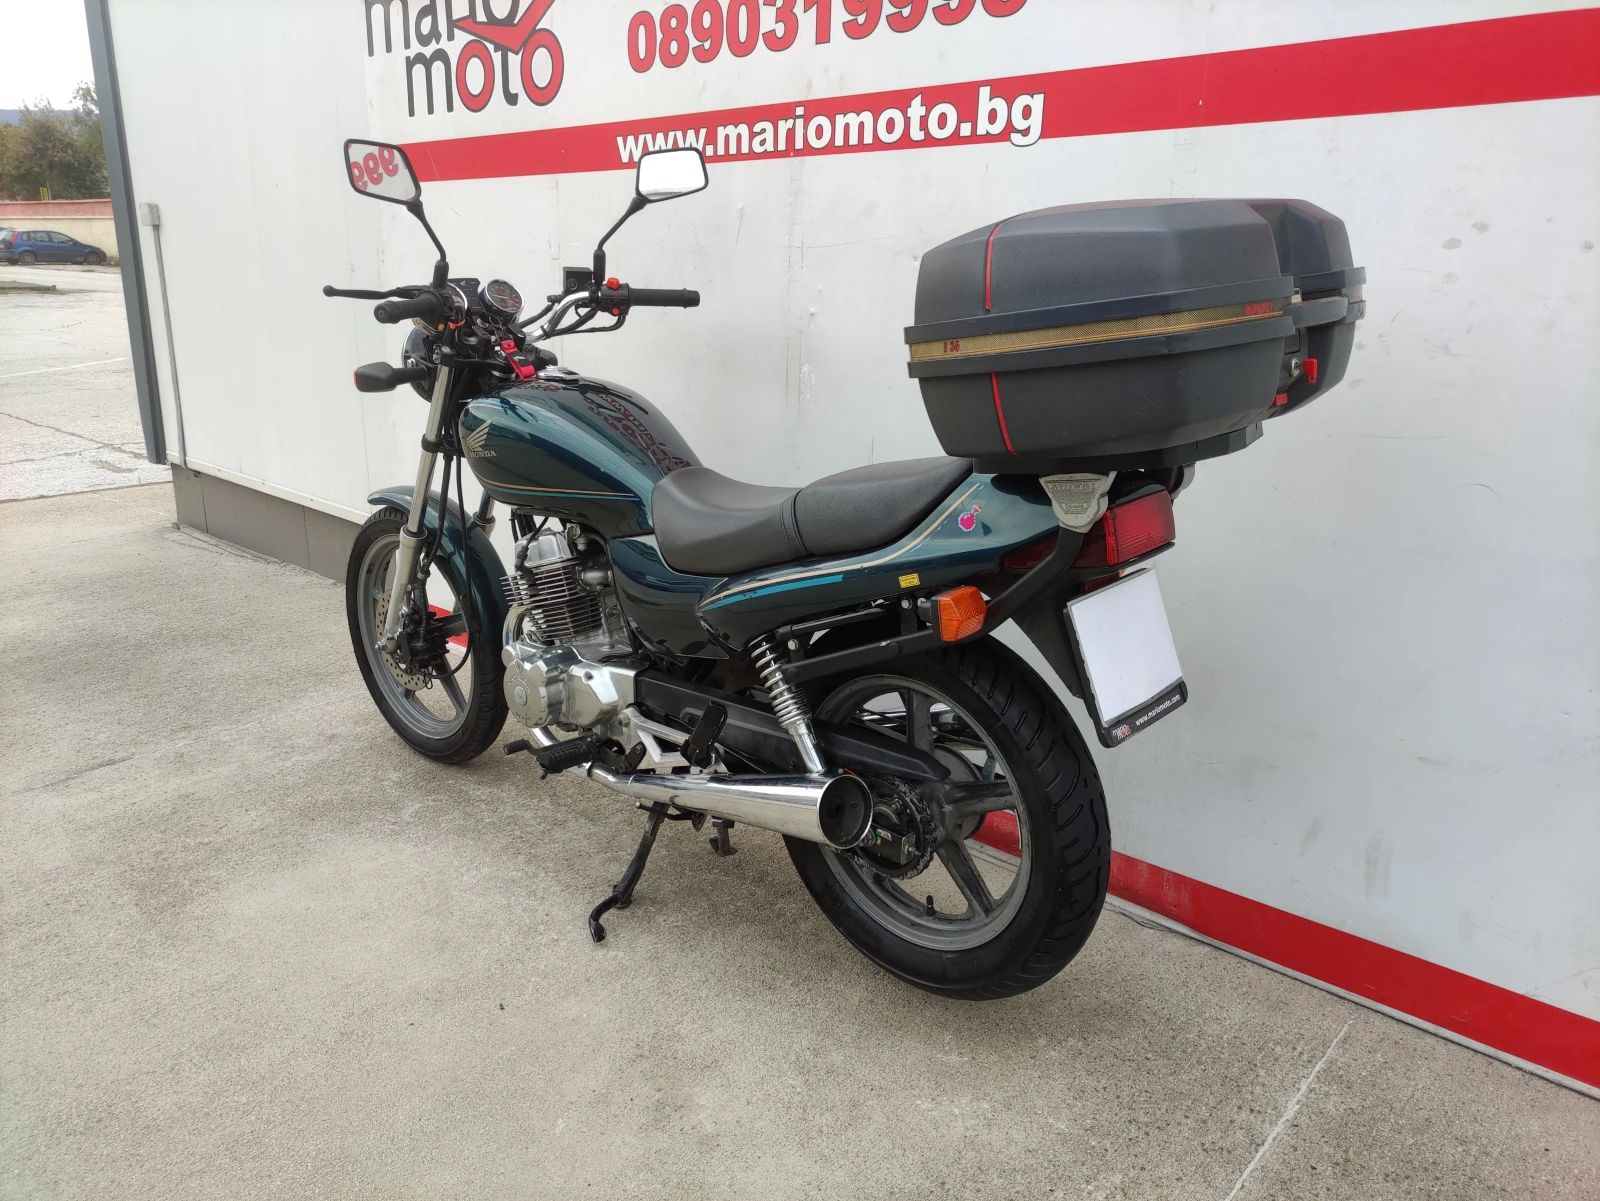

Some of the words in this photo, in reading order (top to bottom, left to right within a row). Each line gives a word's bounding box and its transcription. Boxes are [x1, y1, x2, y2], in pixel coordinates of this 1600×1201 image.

[405, 28, 564, 117] moto
[627, 0, 1028, 73] 0890319
[616, 84, 1046, 164] www.mariomoto.bg
[470, 450, 498, 458] HONDA
[1135, 694, 1181, 727] www.mariomoto.com
